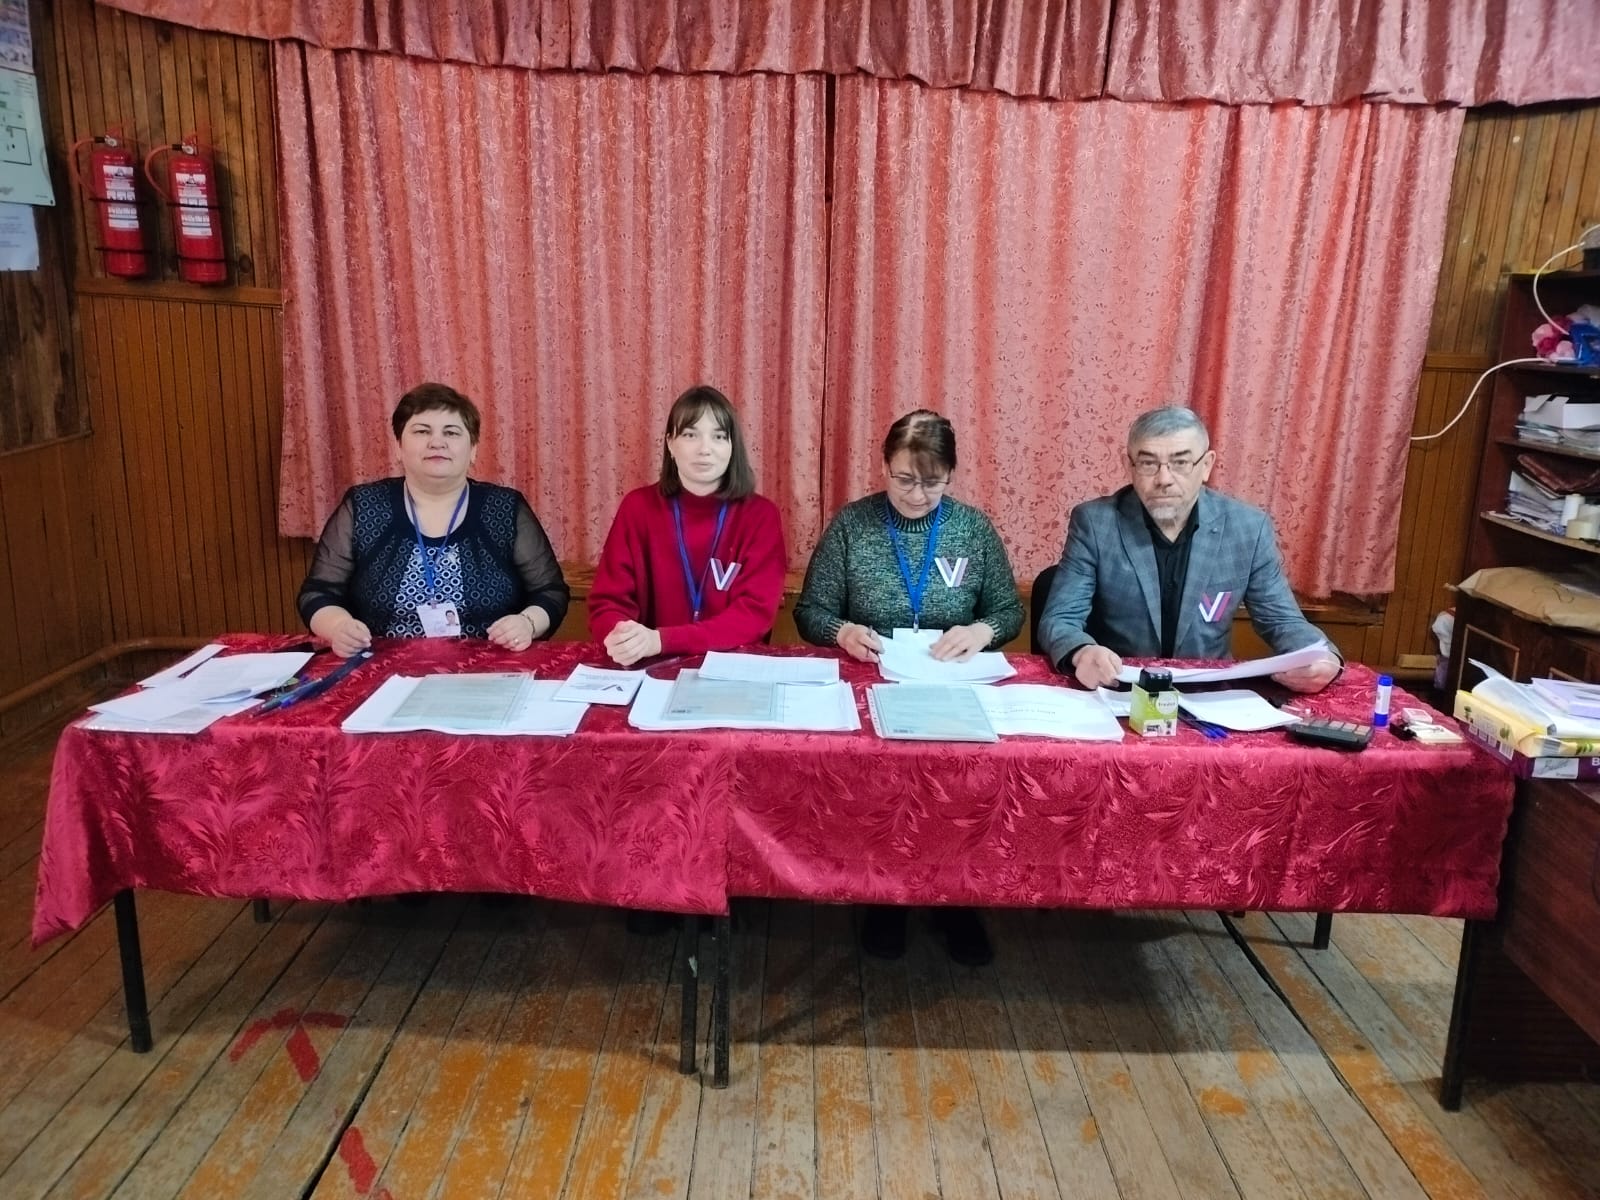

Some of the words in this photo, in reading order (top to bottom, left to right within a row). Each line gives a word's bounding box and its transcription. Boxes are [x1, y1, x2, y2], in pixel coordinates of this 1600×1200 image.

[710, 557, 743, 592] V
[934, 557, 969, 588] V
[1198, 591, 1232, 623] V
[1591, 757, 1600, 766] B
